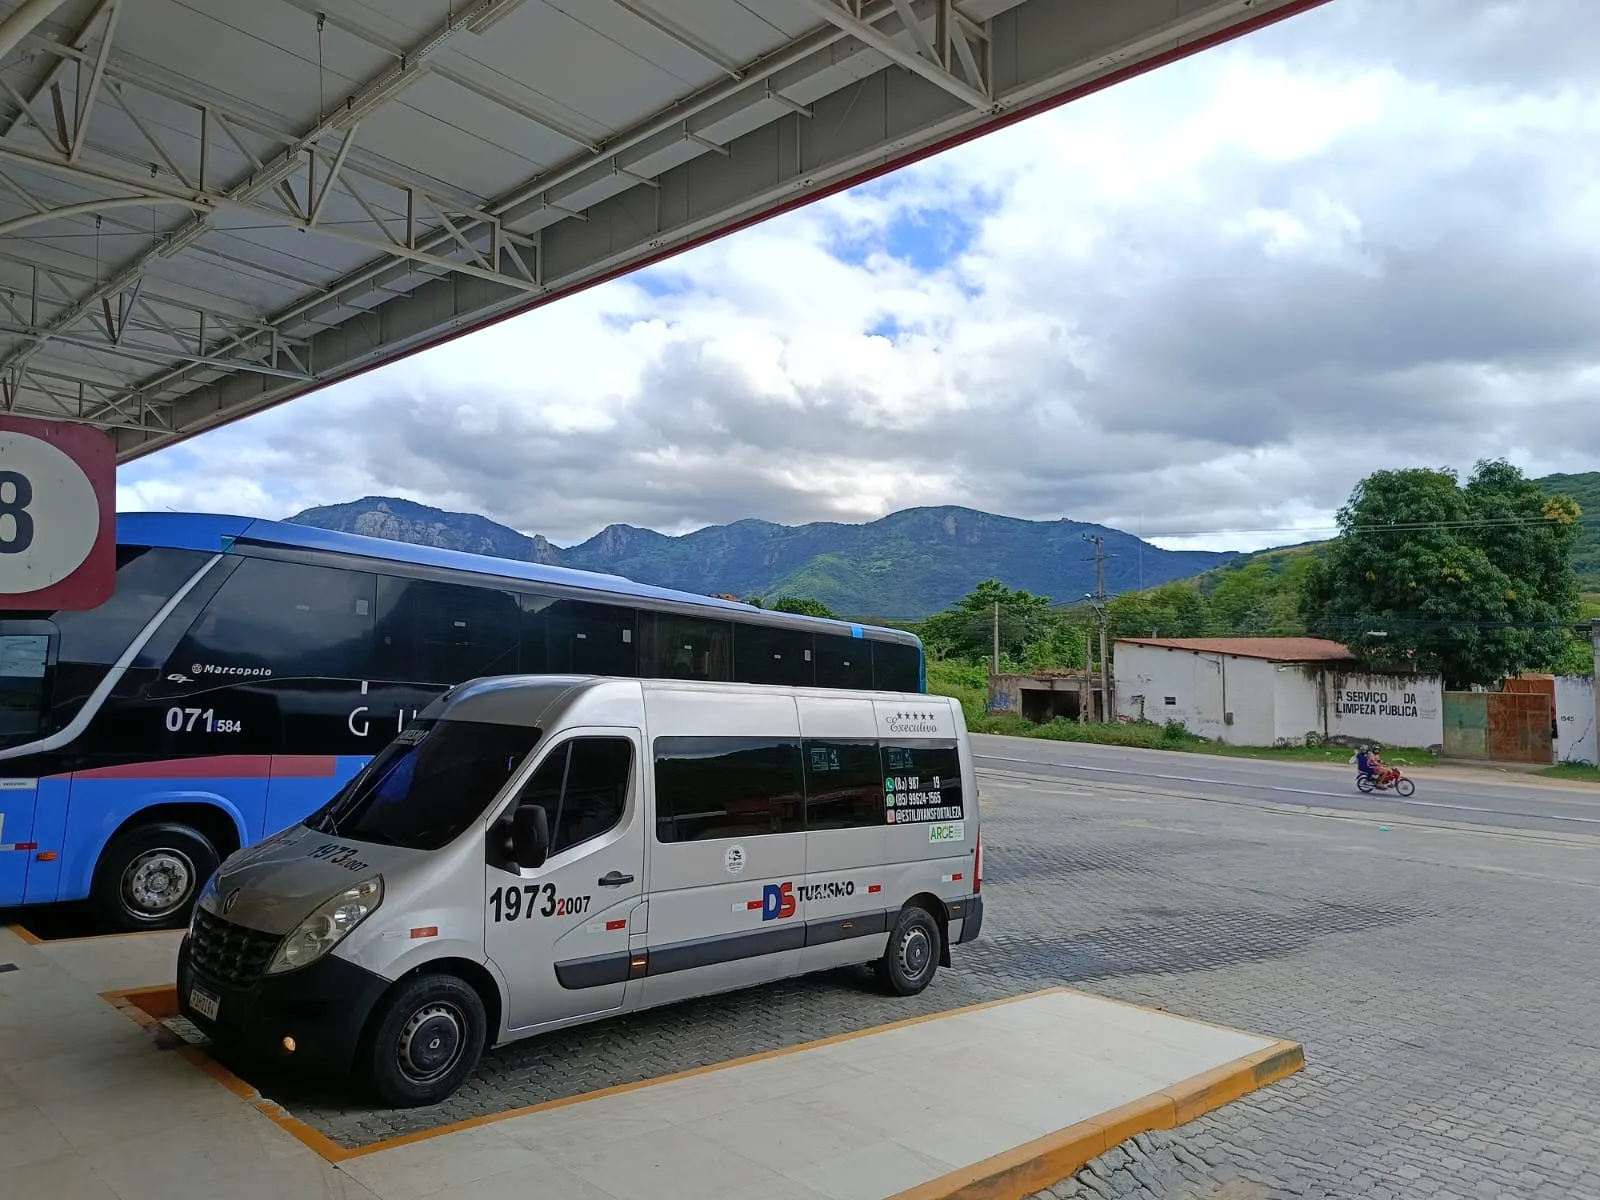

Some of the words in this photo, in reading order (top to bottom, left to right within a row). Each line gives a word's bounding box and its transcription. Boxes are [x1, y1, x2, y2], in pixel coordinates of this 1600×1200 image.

[0, 470, 34, 554] 8
[203, 664, 272, 676] Marcopolo
[1336, 691, 1343, 702] A
[1346, 691, 1388, 704] SERVIÇO
[1403, 693, 1416, 705] DA
[1335, 703, 1376, 715] LIMPEZA
[885, 716, 937, 733] Executivo
[930, 825, 954, 841] ARCE
[762, 881, 796, 921] DS
